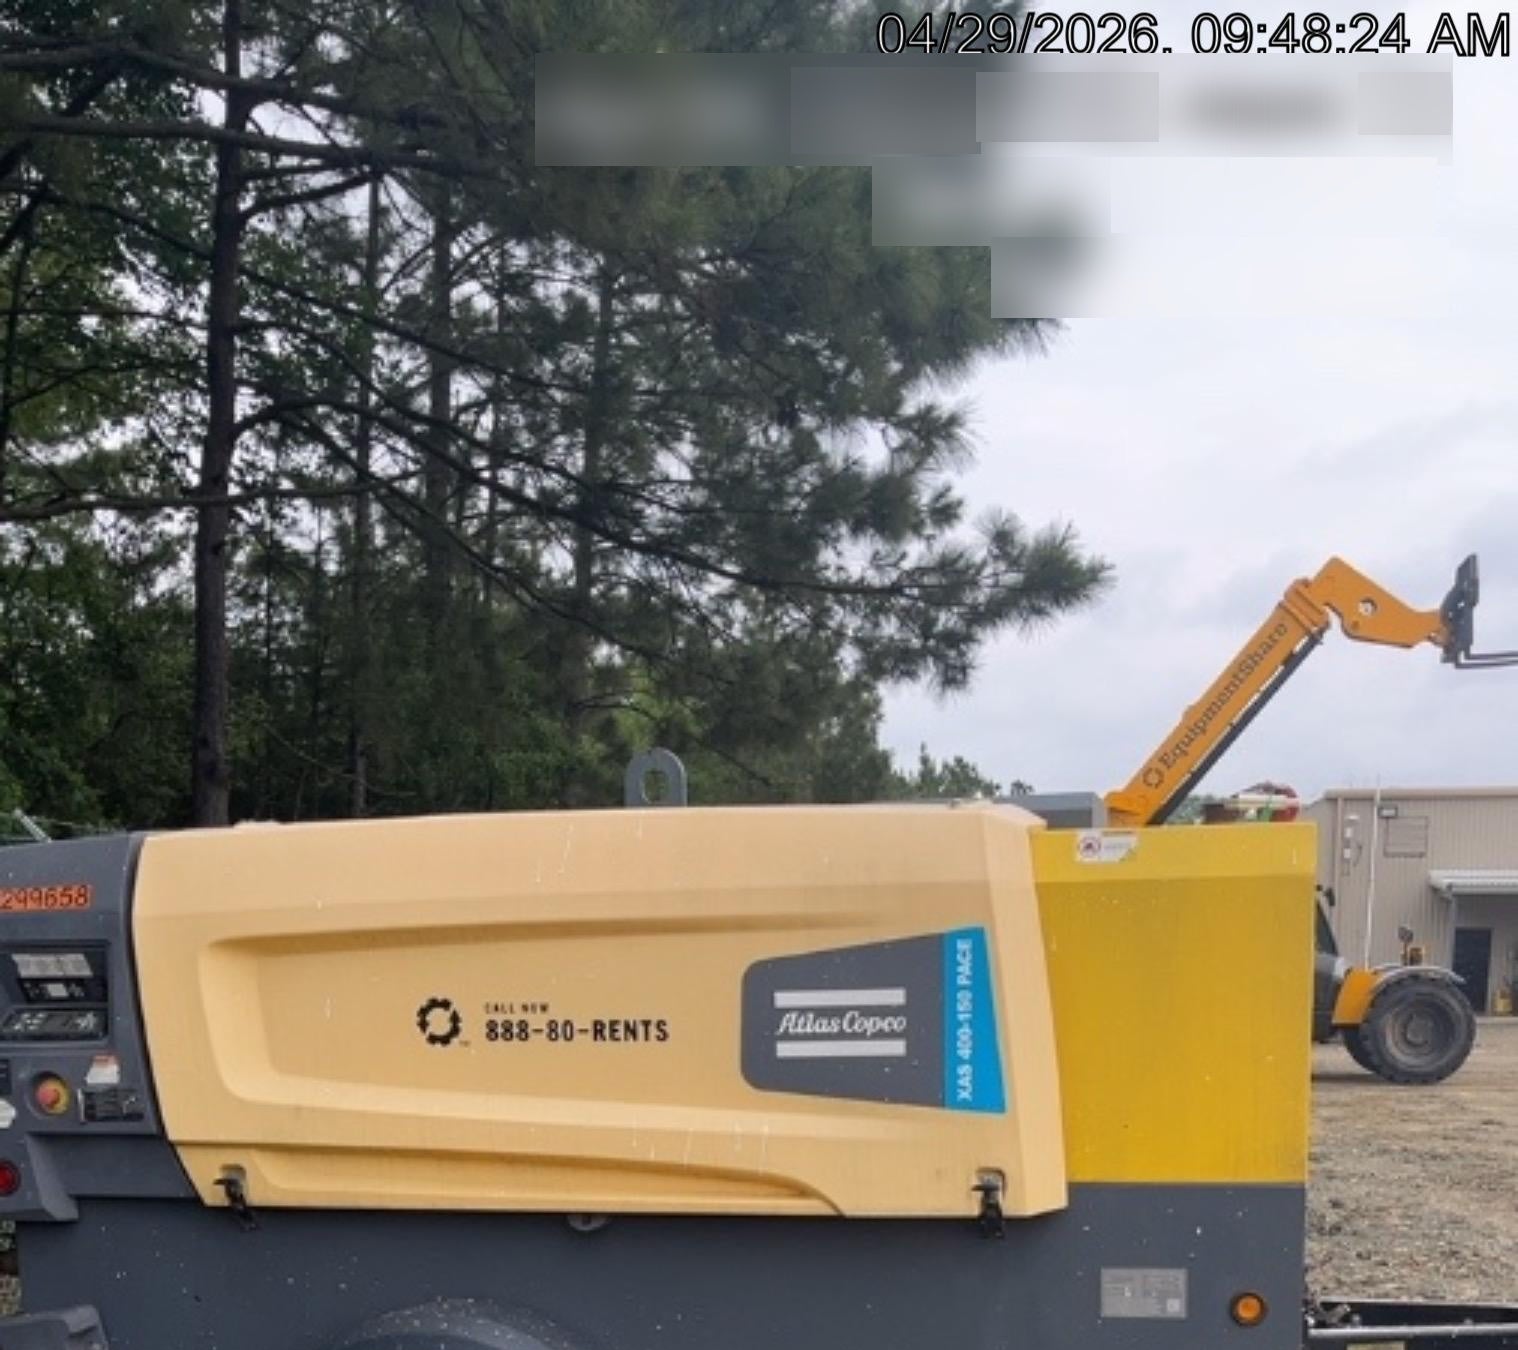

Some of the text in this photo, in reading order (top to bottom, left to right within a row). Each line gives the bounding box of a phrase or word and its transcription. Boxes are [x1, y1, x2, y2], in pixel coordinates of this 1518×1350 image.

[1159, 623, 1287, 770] EquipmentShare
[484, 1002, 550, 1014] CALL NOW
[956, 939, 973, 1101] XAS 400-150 PACE
[485, 1019, 669, 1042] 888-80-RENTS
[776, 1010, 907, 1036] Atlas Copco
